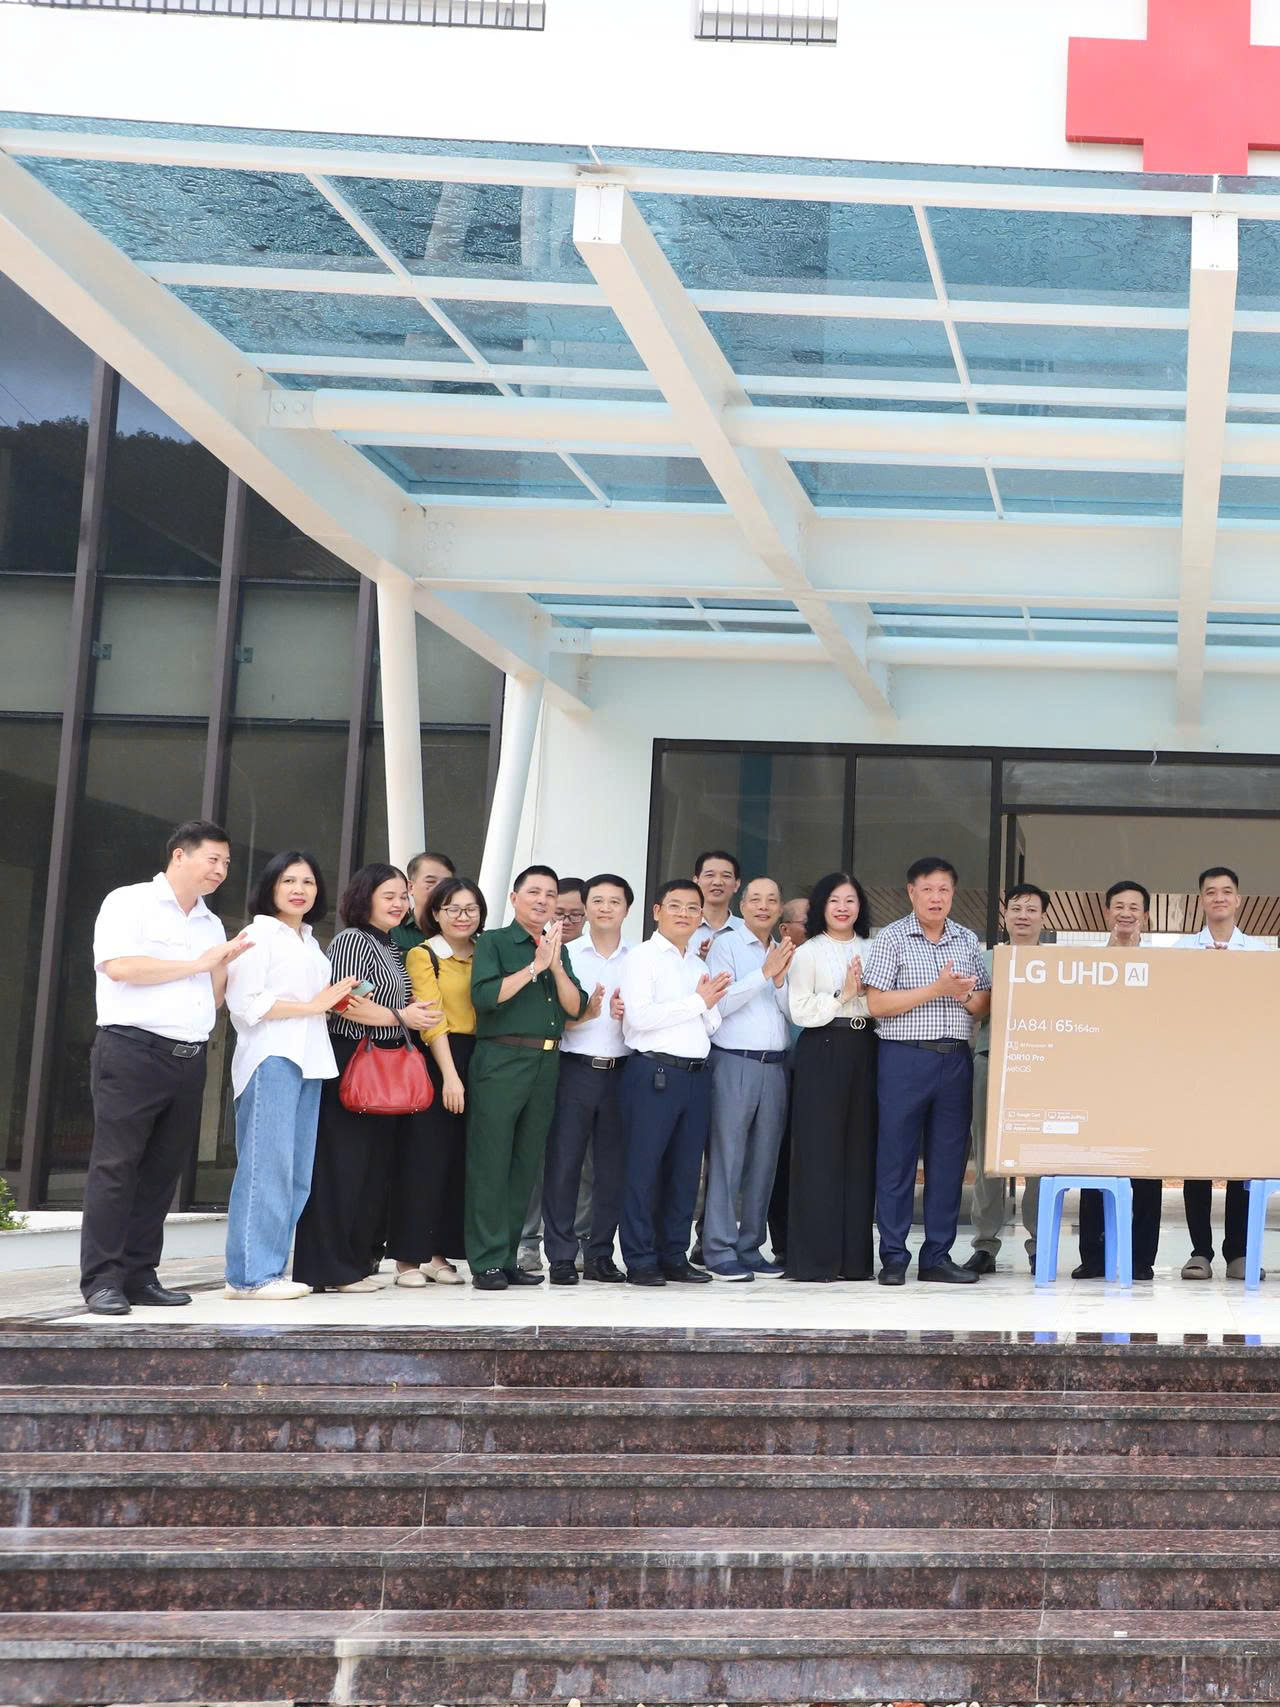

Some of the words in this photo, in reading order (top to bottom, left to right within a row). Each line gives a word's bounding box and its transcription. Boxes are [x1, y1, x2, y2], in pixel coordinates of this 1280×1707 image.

[1009, 959, 1047, 984] LG
[1057, 960, 1119, 985] UHD
[1127, 967, 1145, 982] AI
[1007, 1018, 1047, 1032] UA84
[1055, 1019, 1073, 1033] 65
